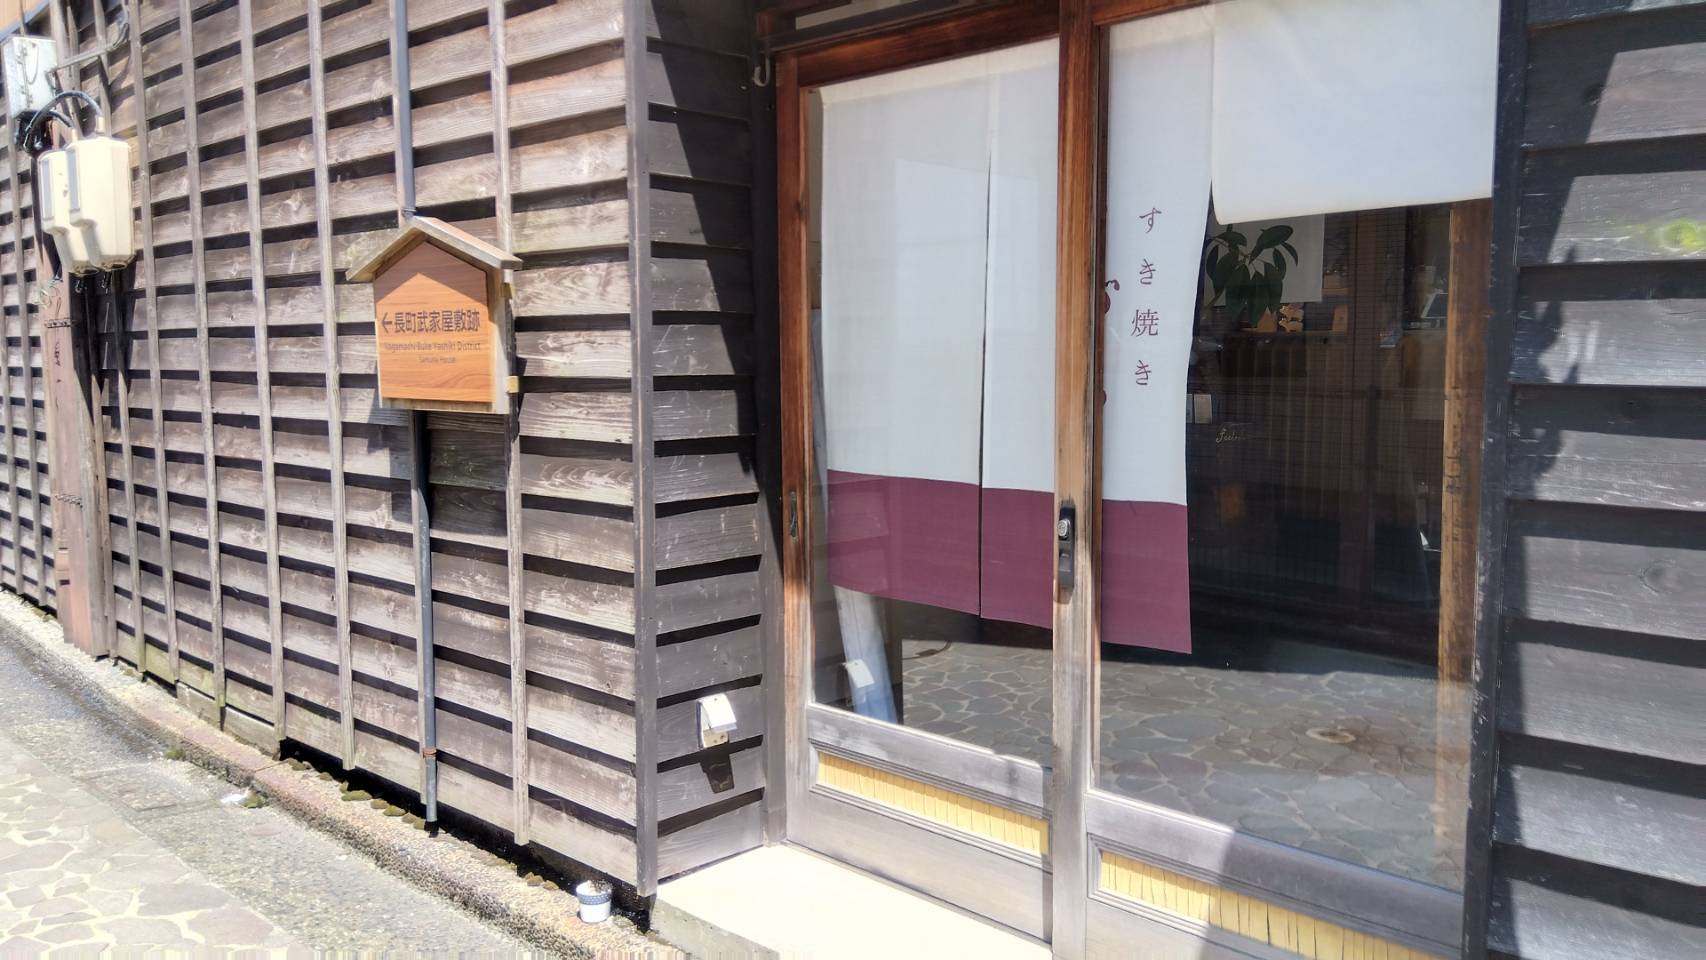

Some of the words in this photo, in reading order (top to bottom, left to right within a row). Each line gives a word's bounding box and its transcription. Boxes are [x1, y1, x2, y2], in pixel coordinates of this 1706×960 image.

[1130, 207, 1162, 386] すき焼き
[395, 309, 481, 333] 長町武家屋敷跡
[457, 340, 481, 351] District
